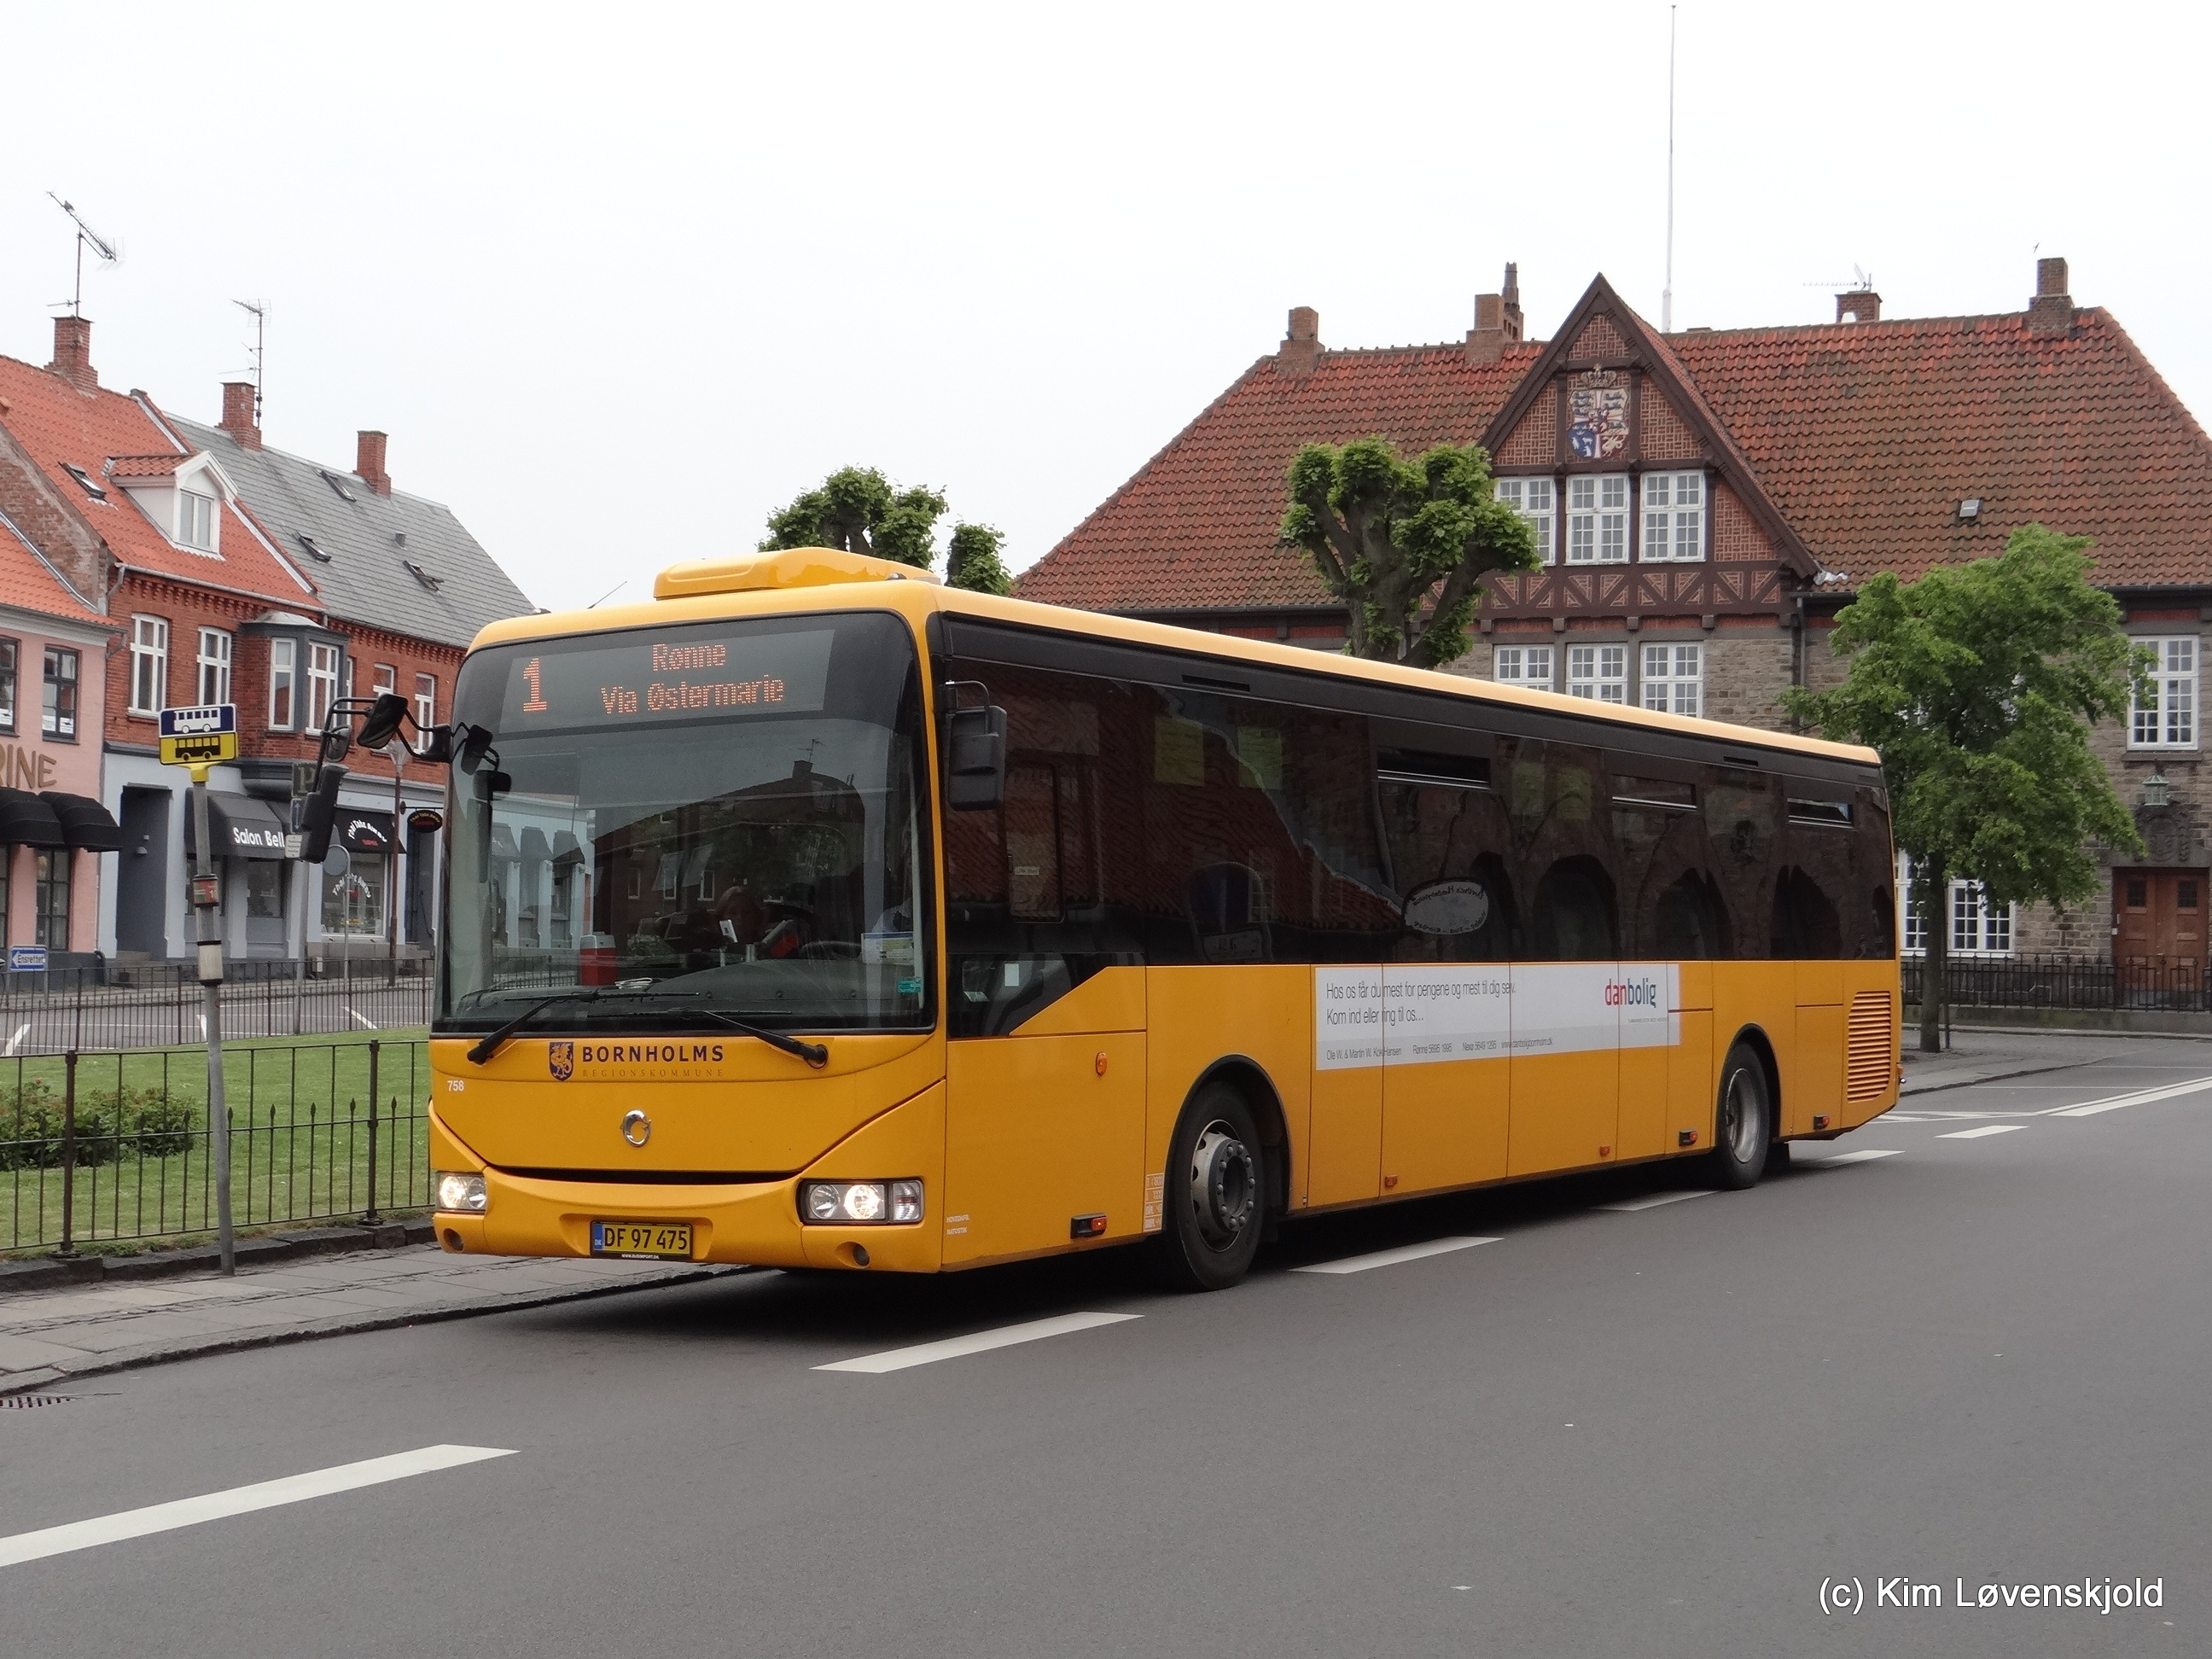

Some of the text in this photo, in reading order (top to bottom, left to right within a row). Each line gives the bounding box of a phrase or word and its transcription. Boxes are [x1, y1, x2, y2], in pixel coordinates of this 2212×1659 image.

[653, 643, 725, 672] Rønne
[523, 658, 547, 712] 1
[601, 673, 784, 714] Via Østermarie
[233, 827, 264, 847] Salon
[1326, 982, 1344, 999] Hos
[1346, 986, 1356, 999] os
[1359, 981, 1370, 998] får
[1371, 982, 1382, 998] du
[1383, 982, 1403, 998] mest
[1405, 981, 1416, 997] for
[1417, 984, 1450, 999] pengene
[1452, 983, 1461, 999] og
[1463, 981, 1481, 996] mest
[1489, 980, 1500, 998] dig
[1604, 977, 1656, 1008] danbolig
[1326, 1009, 1347, 1025] Kom
[1348, 1008, 1361, 1024] ind
[1363, 1007, 1380, 1023] eller
[1382, 1007, 1396, 1026] ring
[582, 1045, 724, 1063] BORNHOLMS
[1326, 1050, 1336, 1060] Ole
[1336, 1050, 1343, 1059] W.
[1344, 1049, 1349, 1059] &
[1349, 1047, 1365, 1058] Martin
[1365, 1047, 1372, 1057] W.
[1412, 1045, 1429, 1055] Rønne
[1441, 1042, 1452, 1053] 1995
[1462, 1042, 1474, 1051] Nexø
[582, 1068, 724, 1078] REGIONSKOMMUNE
[447, 1080, 465, 1091] 758
[604, 1227, 626, 1248] DF
[631, 1228, 652, 1249] 97
[656, 1229, 688, 1250] 475
